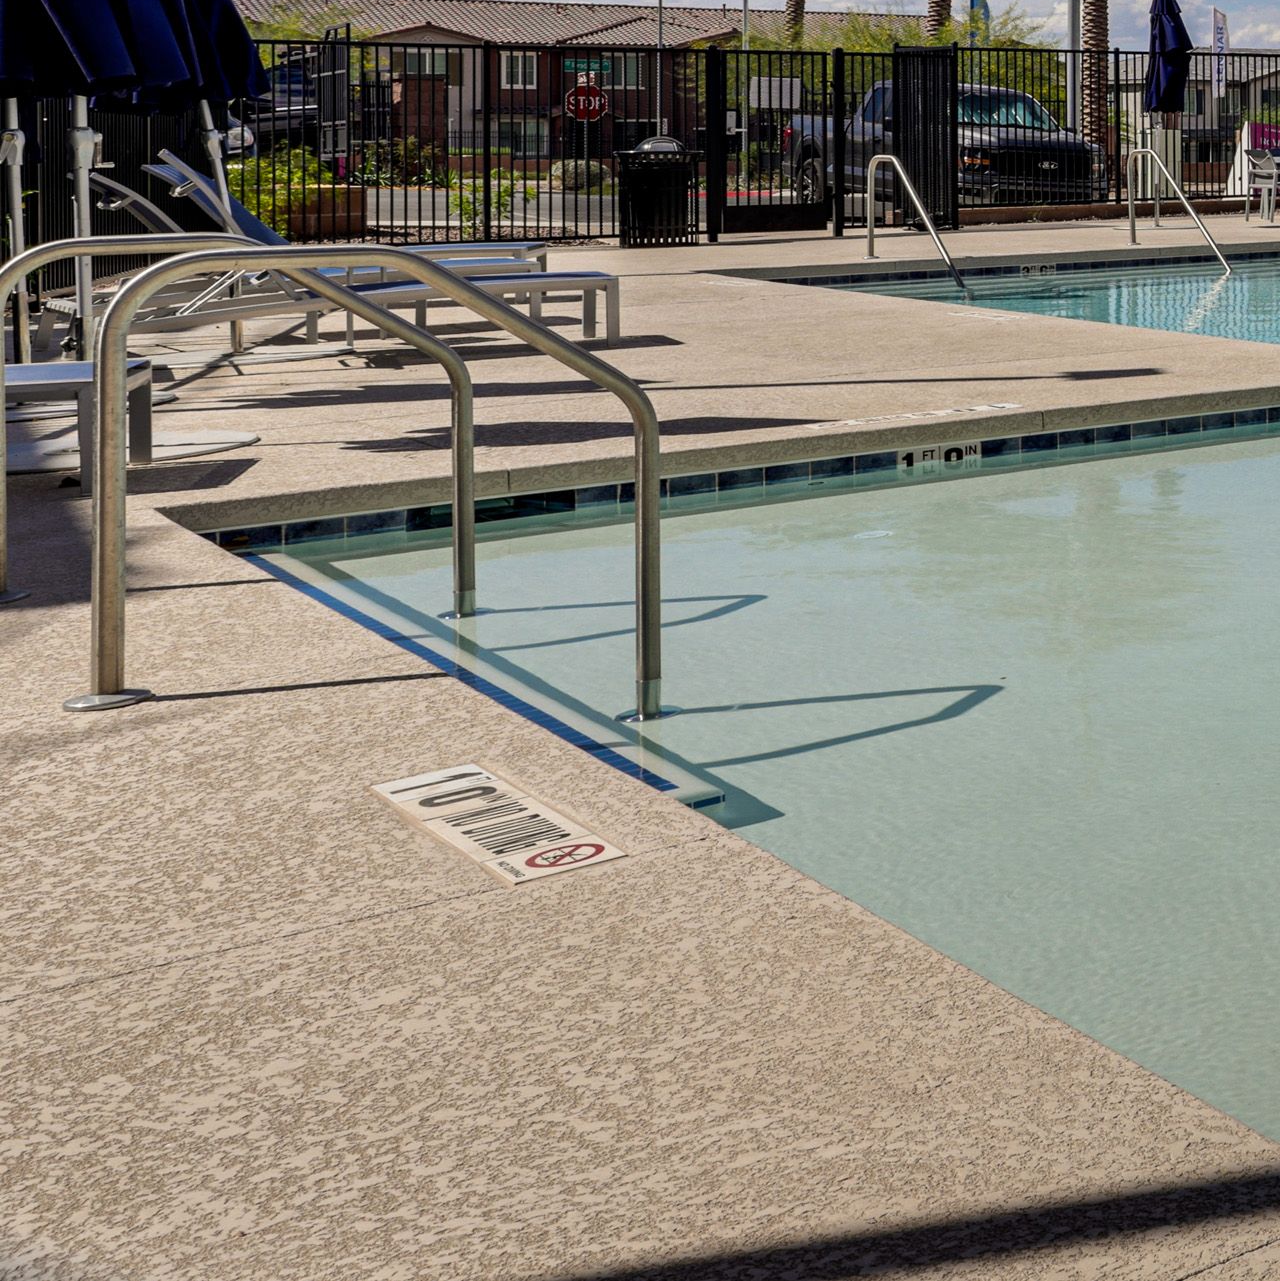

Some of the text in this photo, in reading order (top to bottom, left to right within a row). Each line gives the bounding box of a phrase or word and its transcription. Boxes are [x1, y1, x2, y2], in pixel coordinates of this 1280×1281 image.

[1216, 25, 1224, 83] LENNAR
[568, 96, 605, 110] STOP
[902, 452, 914, 467] 1
[922, 449, 935, 460] FT
[965, 445, 977, 456] IN
[389, 771, 484, 795] 1
[418, 786, 497, 808] 0
[441, 801, 571, 856] NO DIVING
